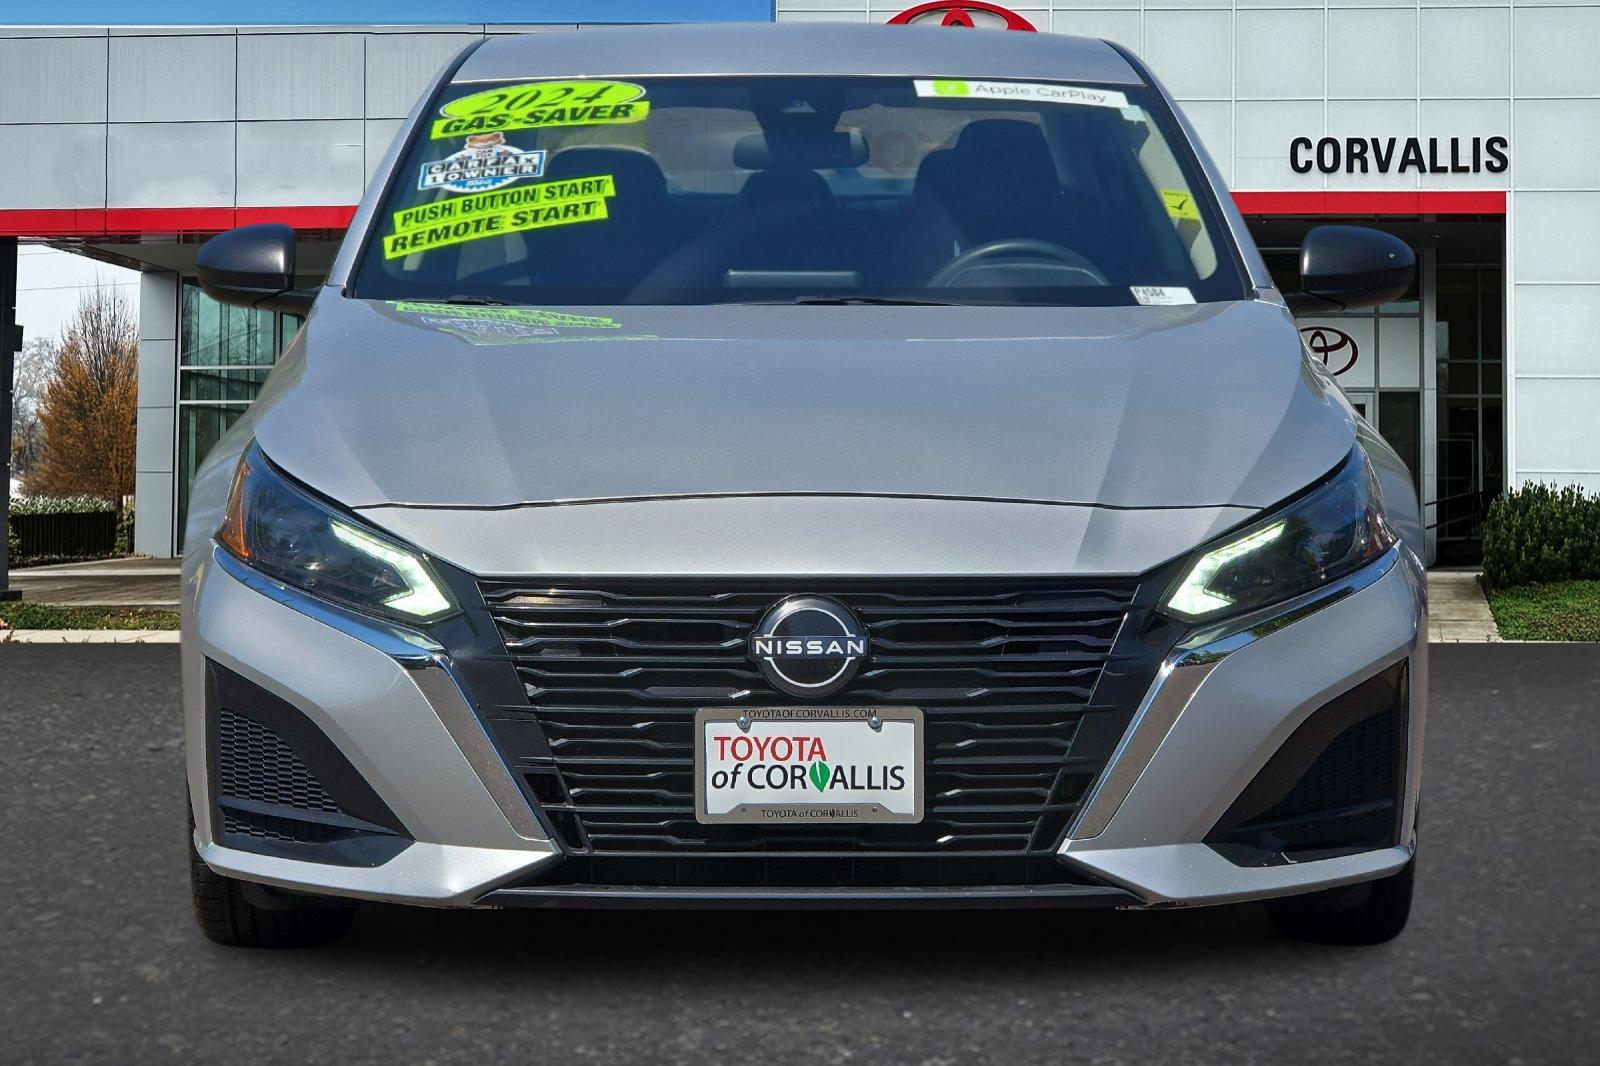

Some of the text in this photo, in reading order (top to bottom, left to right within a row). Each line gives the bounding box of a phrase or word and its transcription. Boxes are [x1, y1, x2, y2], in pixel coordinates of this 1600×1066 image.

[470, 84, 614, 115] 2024
[975, 84, 1107, 103] Apple CarPlay
[441, 103, 634, 135] GAS-SAVER
[430, 156, 536, 174] CARFAX
[1290, 136, 1509, 174] CORVALLIS
[446, 165, 534, 181] OWNER
[401, 177, 607, 227] PUSH BUTTON START
[390, 200, 597, 253] REMOTE START
[755, 640, 864, 655] NISSAN
[742, 709, 877, 719] TOYOTAOFCORVALLIS.COM
[713, 736, 827, 762] TOYOTA
[711, 763, 743, 790] of
[761, 810, 797, 818] TOYOTA
[799, 809, 809, 818] of
